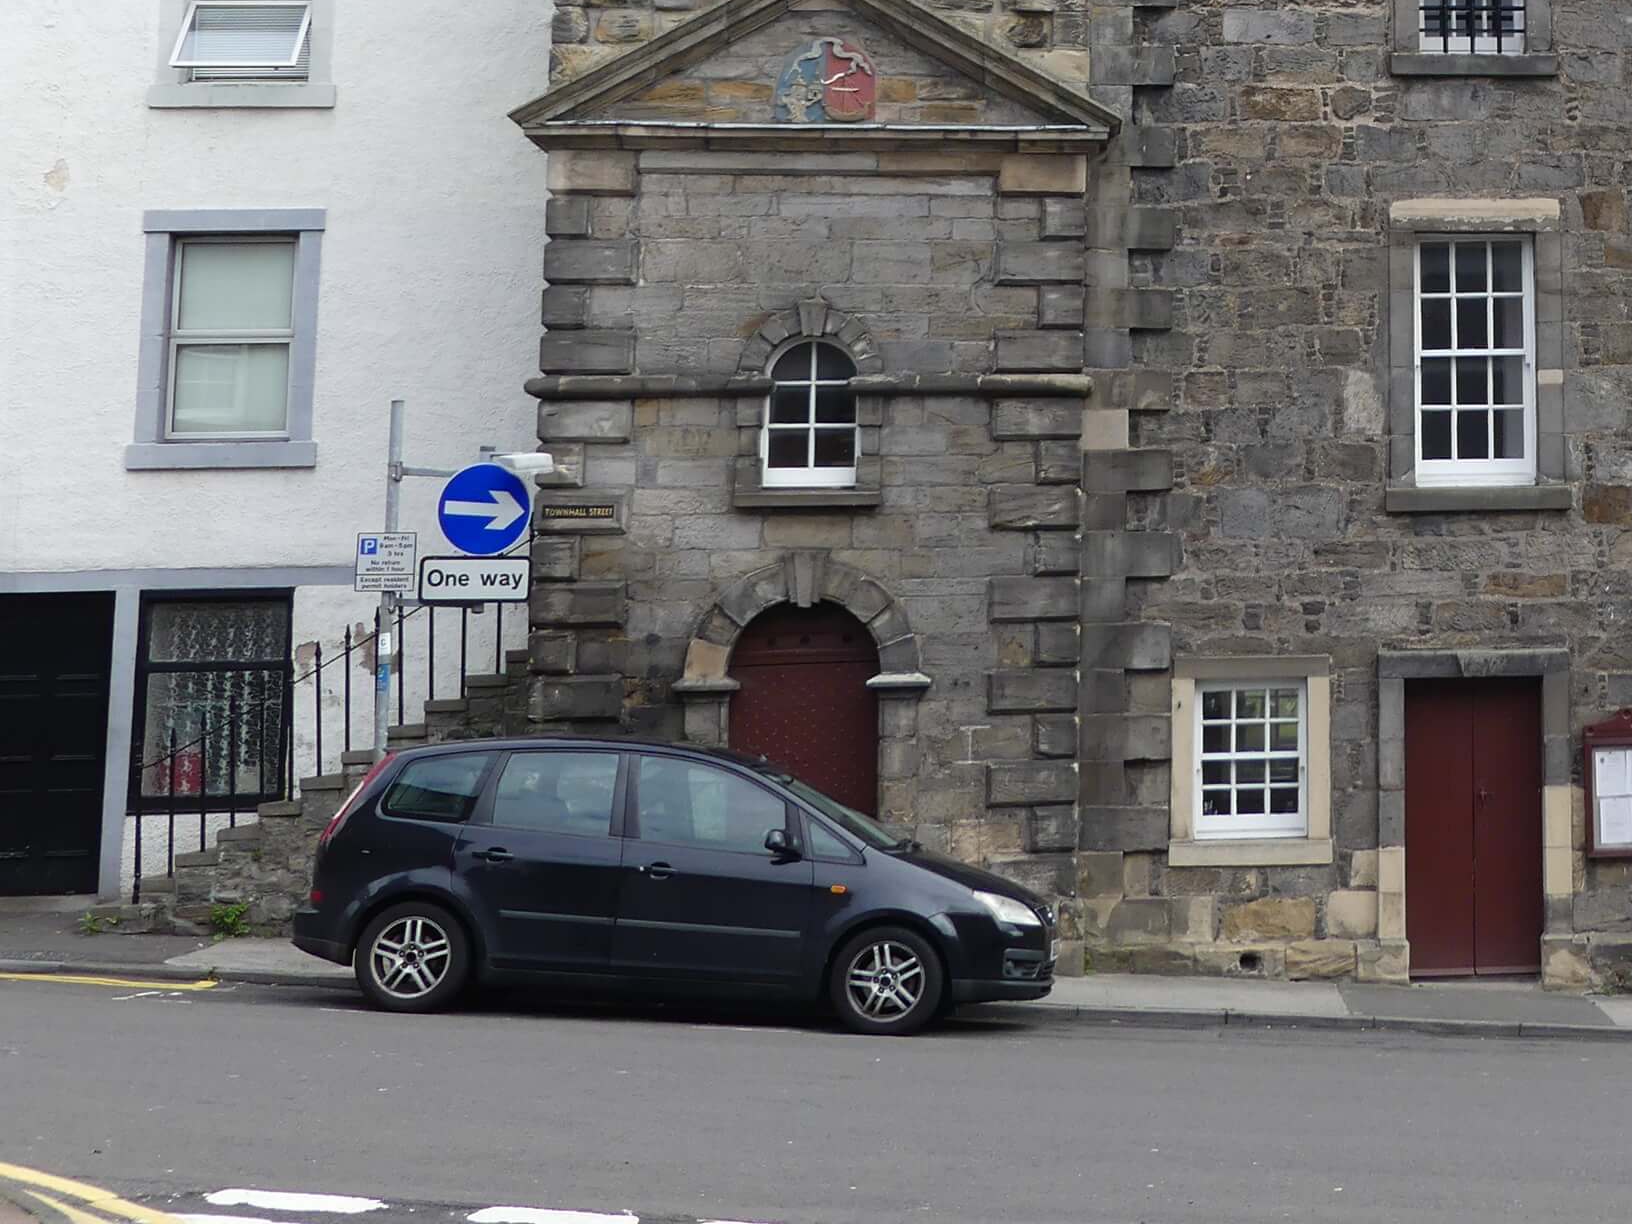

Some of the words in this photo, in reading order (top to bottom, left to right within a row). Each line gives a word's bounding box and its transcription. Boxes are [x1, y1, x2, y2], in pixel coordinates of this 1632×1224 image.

[545, 507, 586, 517] TOWNHALL
[588, 507, 613, 517] STREET
[364, 539, 376, 554] P
[360, 576, 382, 584] Except
[427, 569, 470, 587] One
[480, 573, 523, 590] way
